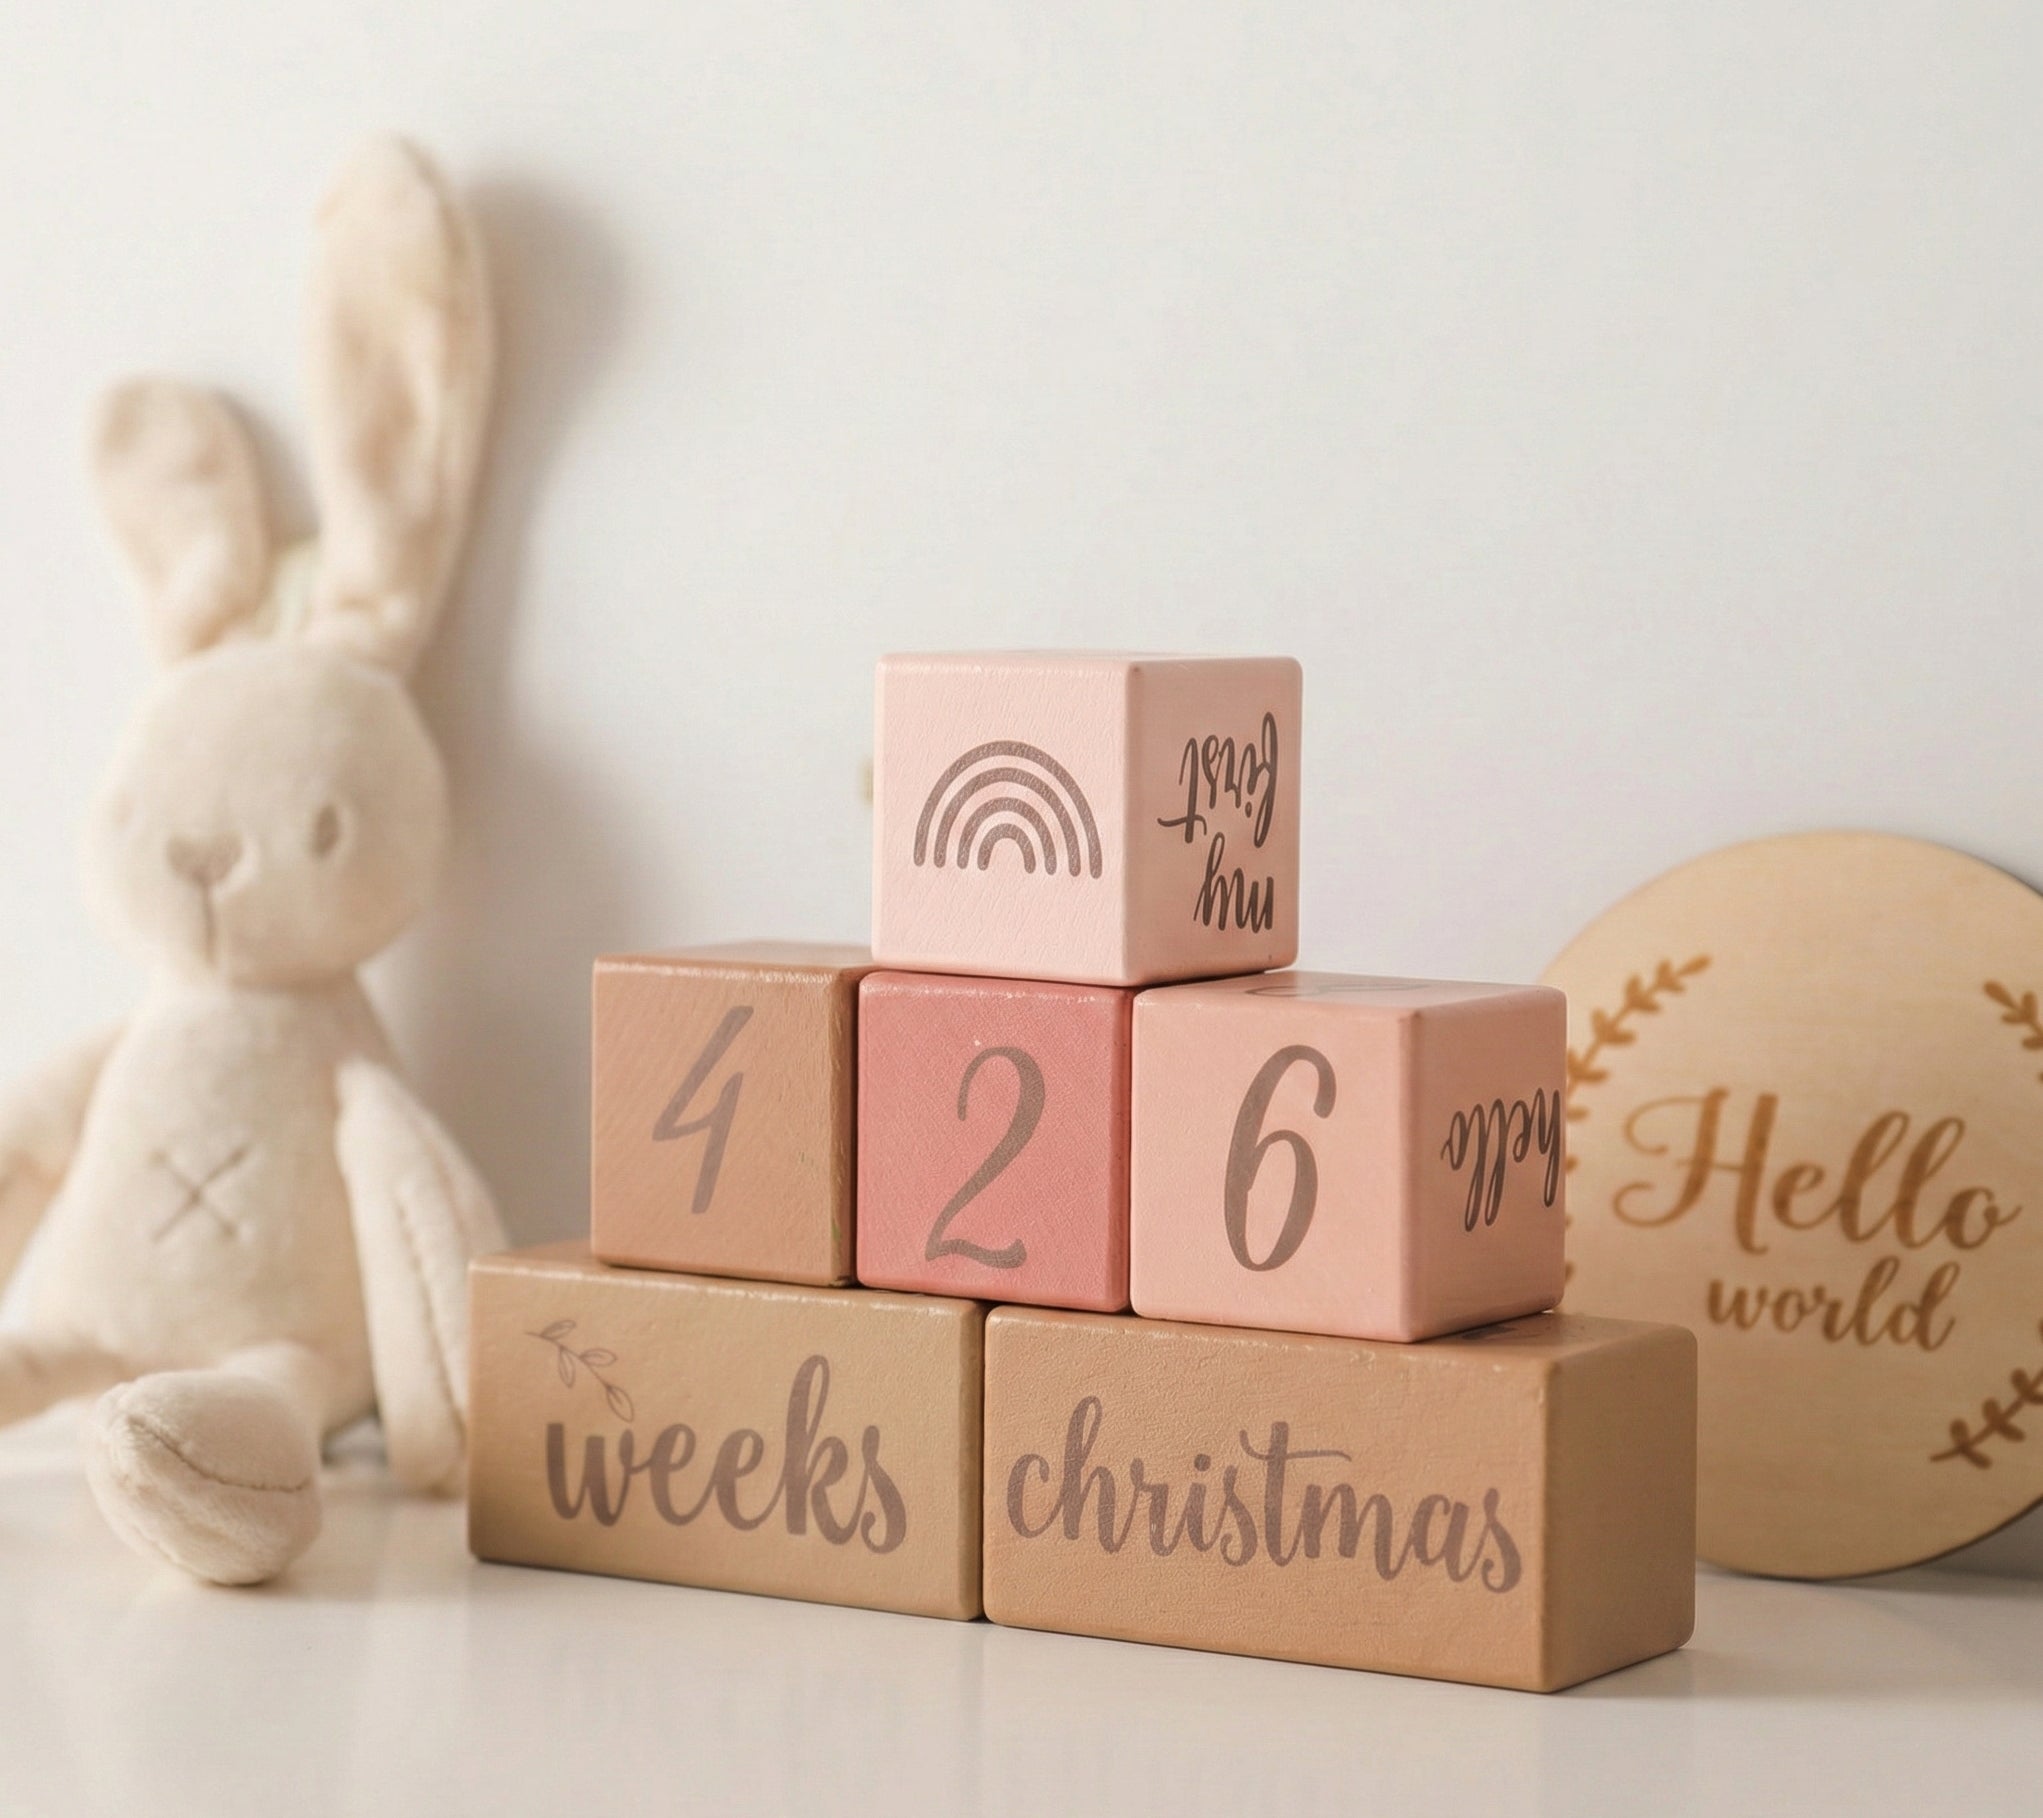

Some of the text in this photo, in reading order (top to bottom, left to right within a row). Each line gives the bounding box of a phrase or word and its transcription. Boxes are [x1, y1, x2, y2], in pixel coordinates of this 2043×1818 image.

[1157, 711, 1278, 848] first
[1193, 832, 1274, 934] my
[652, 1005, 754, 1214] 4
[925, 1045, 1046, 1269] 2
[1223, 1043, 1337, 1272] 6
[1440, 1088, 1560, 1233] hello
[1612, 1086, 2021, 1255] Hello
[1706, 1256, 1961, 1351] world
[546, 1354, 908, 1554] weeks
[1006, 1395, 1523, 1594] christmas
